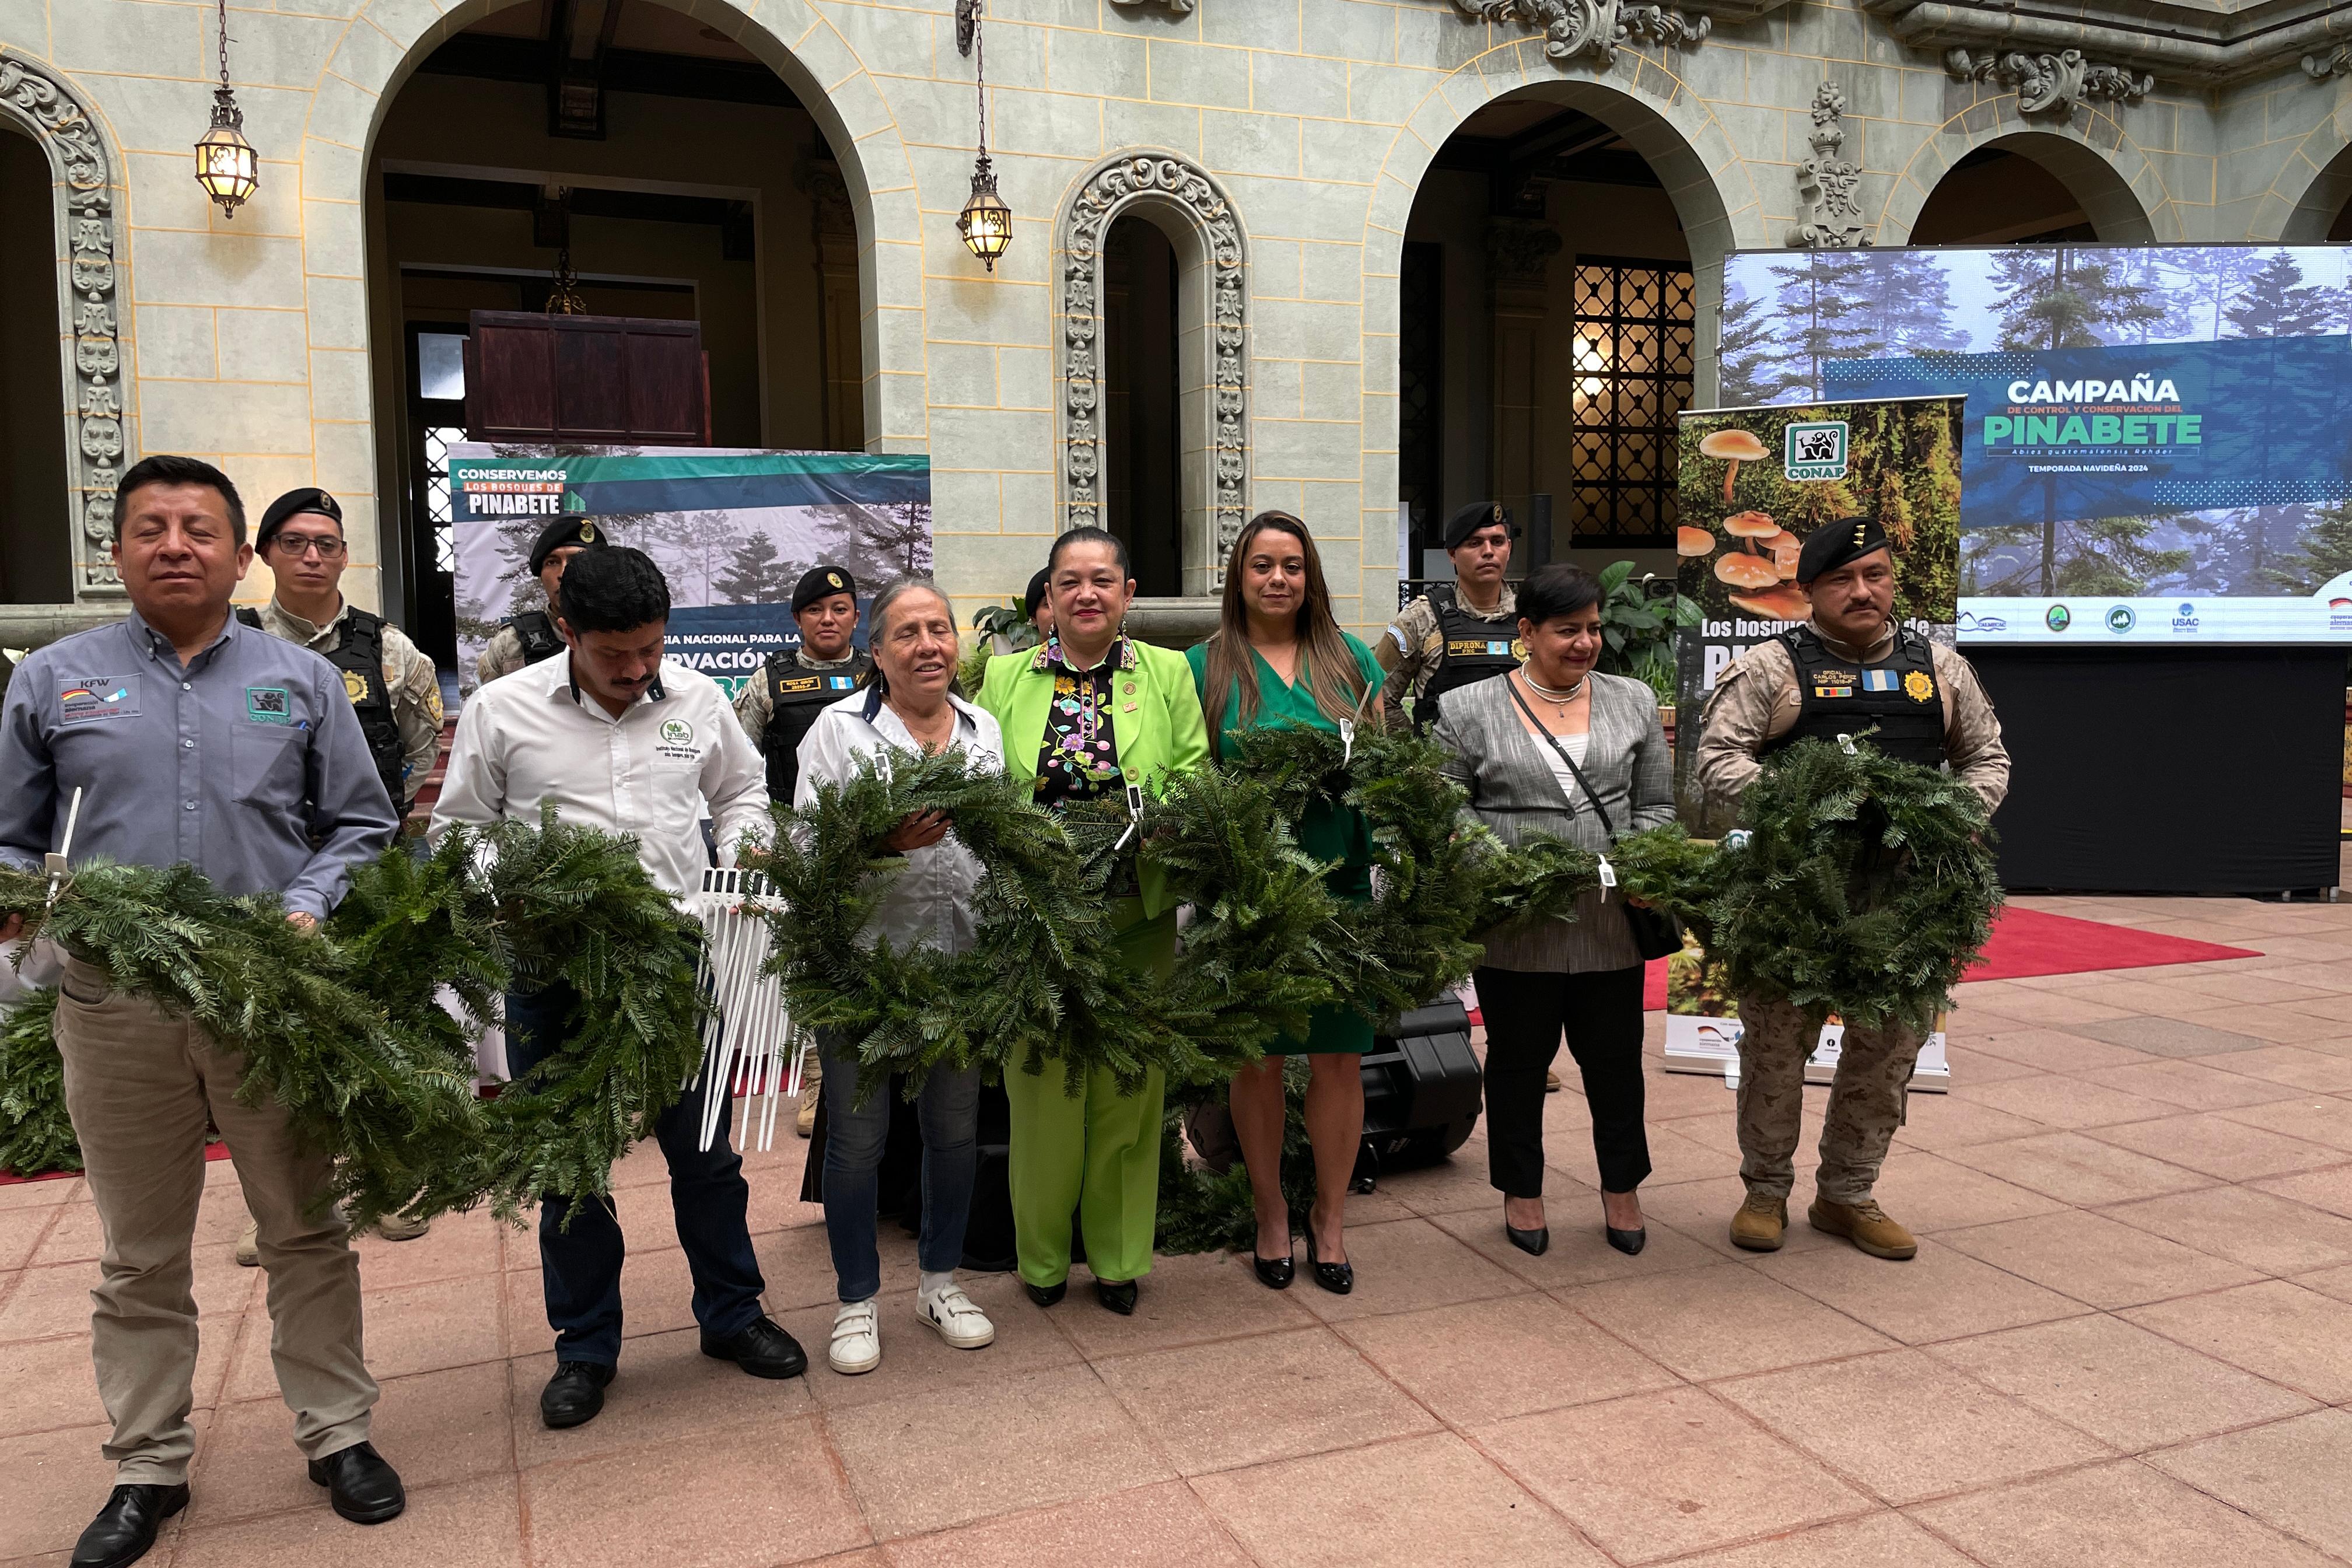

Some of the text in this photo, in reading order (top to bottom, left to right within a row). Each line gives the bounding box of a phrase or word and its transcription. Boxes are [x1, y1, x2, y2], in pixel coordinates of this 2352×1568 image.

[2007, 373, 2180, 404] CAMPAÑA
[2007, 404, 2183, 414] DE CONTROL Y CONSERVACIÓN DEL
[1984, 414, 2202, 445] PINABETE
[1788, 467, 1845, 479] CONAP
[2082, 463, 2127, 473] NAVIDEÑA
[458, 468, 567, 481] CONSERVEMOS
[466, 482, 561, 492] LOS BOSQUES DE
[469, 494, 560, 514] PINABETE
[1701, 618, 1732, 637] Los
[1903, 617, 1930, 636] de
[2172, 618, 2199, 626] USAC
[683, 634, 747, 645] NACIONAL
[749, 634, 783, 644] PARA
[785, 634, 802, 643] LA
[1450, 642, 1487, 650] DIPRONA
[80, 679, 110, 688] KFW
